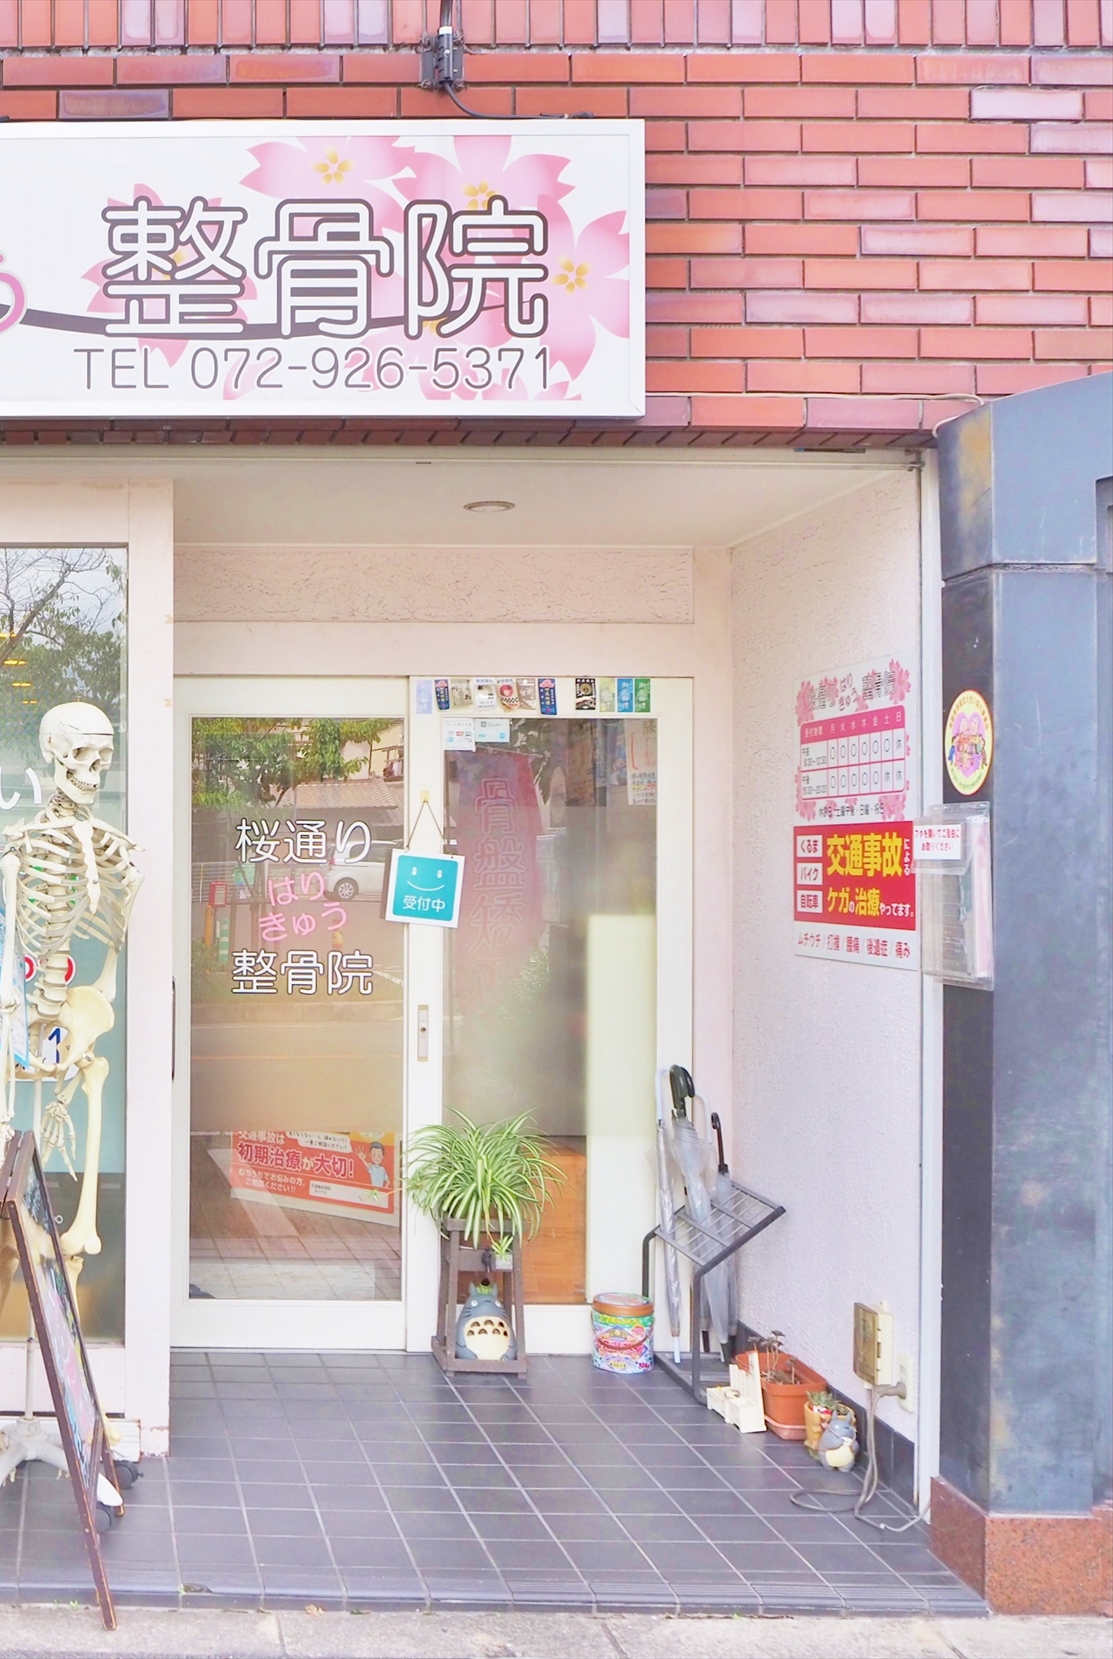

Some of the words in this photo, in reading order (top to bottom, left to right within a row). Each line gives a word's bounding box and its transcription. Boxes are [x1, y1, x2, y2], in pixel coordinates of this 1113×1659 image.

[101, 195, 549, 339] 整骨院
[74, 347, 169, 389] TEL
[190, 347, 550, 389] 072-926-5371
[235, 816, 372, 865] 桜通り
[800, 839, 819, 849] くるま
[826, 832, 903, 878] 交通事故
[267, 870, 326, 907] はり
[800, 866, 819, 882] バイク
[258, 901, 348, 943] きゅう
[402, 895, 447, 914] 受付中
[231, 947, 374, 996] 整骨院
